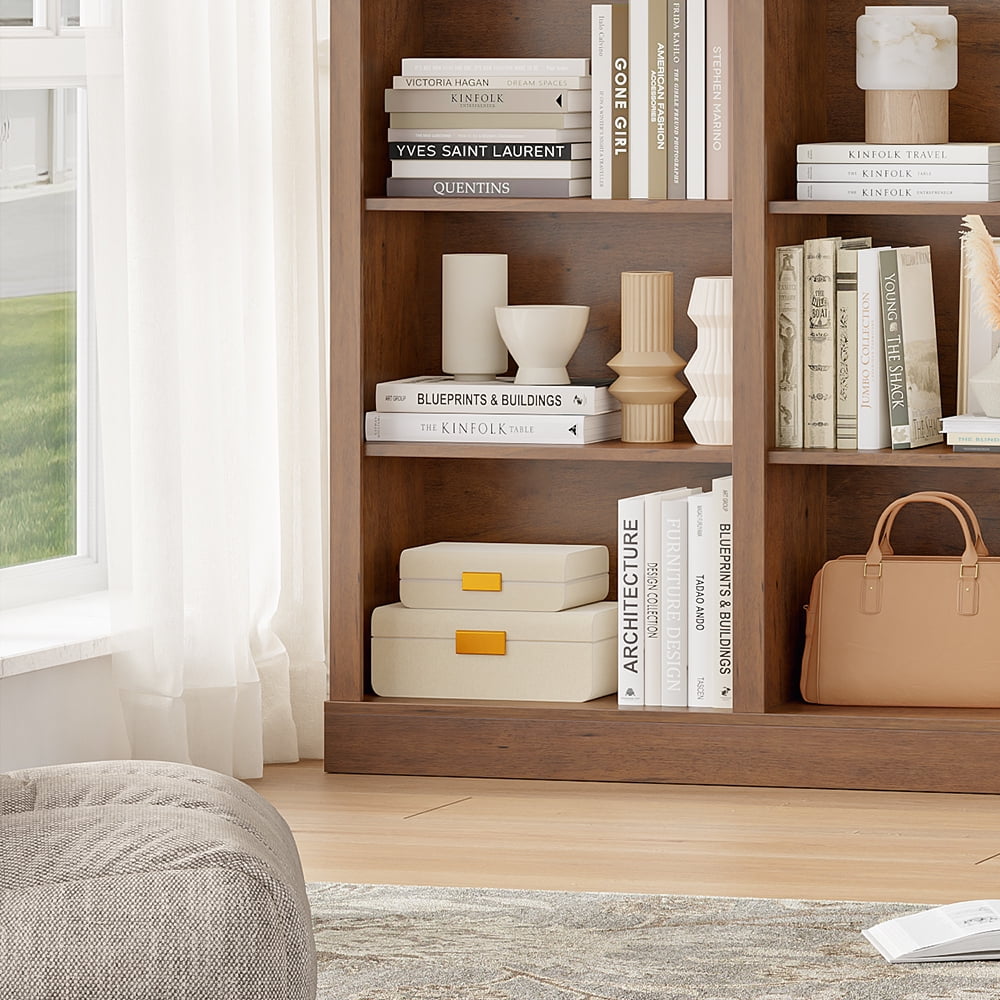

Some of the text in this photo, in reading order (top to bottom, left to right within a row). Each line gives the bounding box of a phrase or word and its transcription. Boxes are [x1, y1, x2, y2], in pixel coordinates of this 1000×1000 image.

[672, 2, 680, 64] FRIDA KAHLO
[405, 78, 568, 87] VICTORIA HAGAN DREAM SPACES
[451, 93, 504, 103] KINFOLK
[614, 57, 628, 156] GONE GIRL
[656, 41, 665, 150] AMERICAN FASHION
[712, 46, 722, 152] STEPHEN MARINO
[396, 144, 565, 158] YVES SAINT LAURENT
[848, 150, 948, 160] KINFOLK TRAVEL
[861, 169, 913, 178] KINFOLK
[433, 181, 511, 196] QUENTINS
[861, 188, 913, 198] KINFOLK
[861, 291, 871, 409] JUMBO COLLECTION
[884, 273, 905, 409] YOUNG THE SHACK
[417, 393, 562, 407] BLUEPRINTS & BUILDINGS
[420, 421, 535, 436] THE KINFOLK TABLE
[623, 518, 639, 674] ARCHITECTURE
[647, 562, 658, 639] DESIGN COLLECTION
[666, 518, 681, 692] FURNITURE DESIGN
[695, 574, 705, 631] TADAO ANDO
[719, 523, 731, 676] BLUEPRINTS & BUILDINGS
